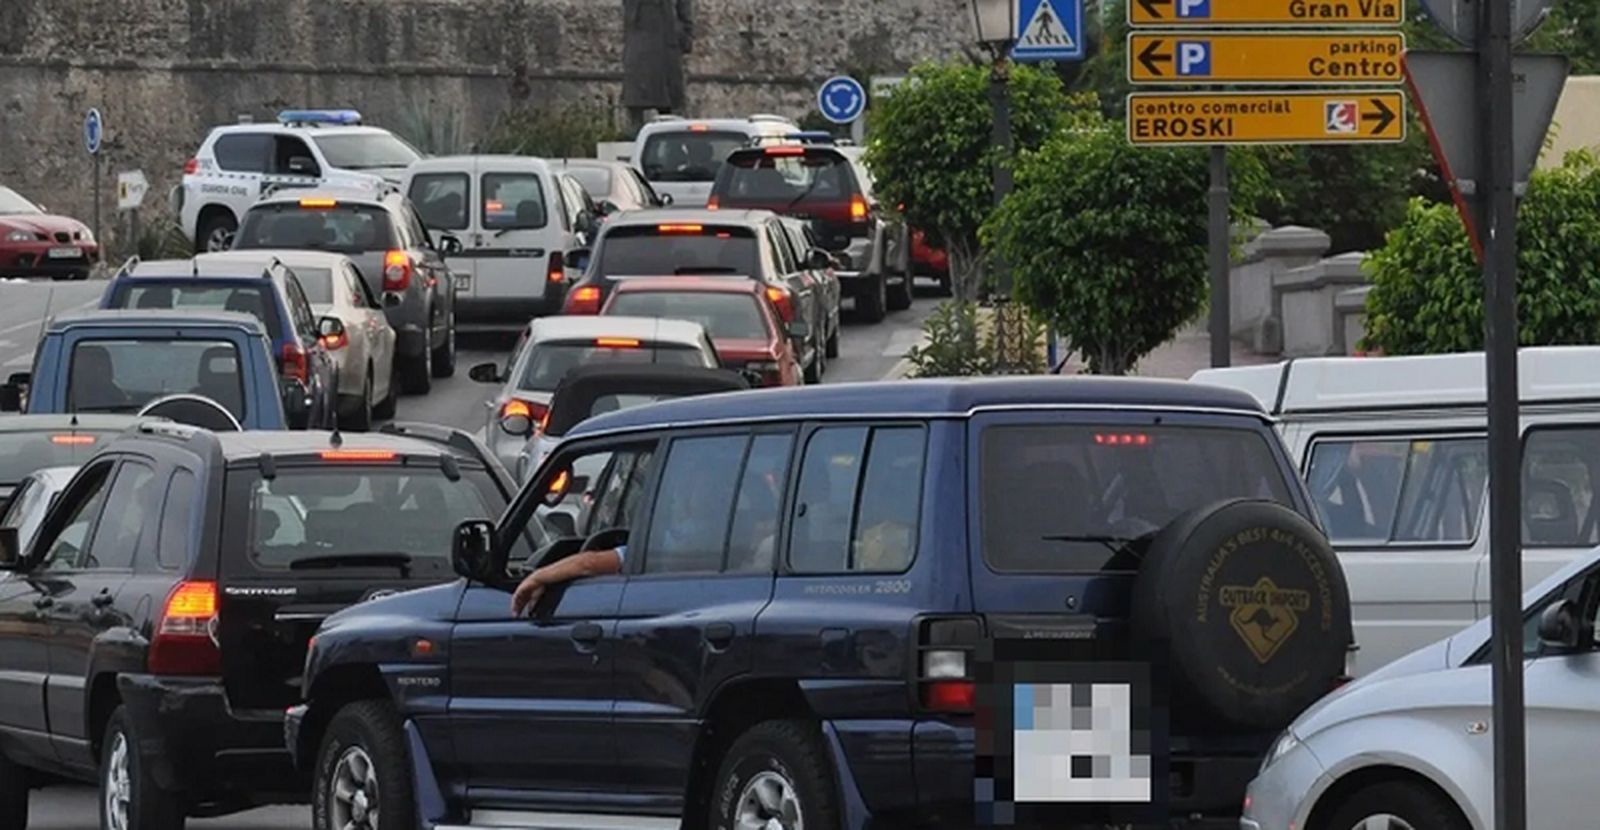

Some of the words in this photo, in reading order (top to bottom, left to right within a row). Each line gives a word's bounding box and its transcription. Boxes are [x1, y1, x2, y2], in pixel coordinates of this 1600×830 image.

[1289, 0, 1348, 17] Gran
[1358, 0, 1395, 17] Vía
[1330, 41, 1396, 56] parking
[1181, 43, 1205, 74] P
[1308, 56, 1397, 76] Centro
[1135, 101, 1196, 115] centro
[1201, 99, 1291, 114] comercial
[1135, 117, 1233, 137] EROSKI
